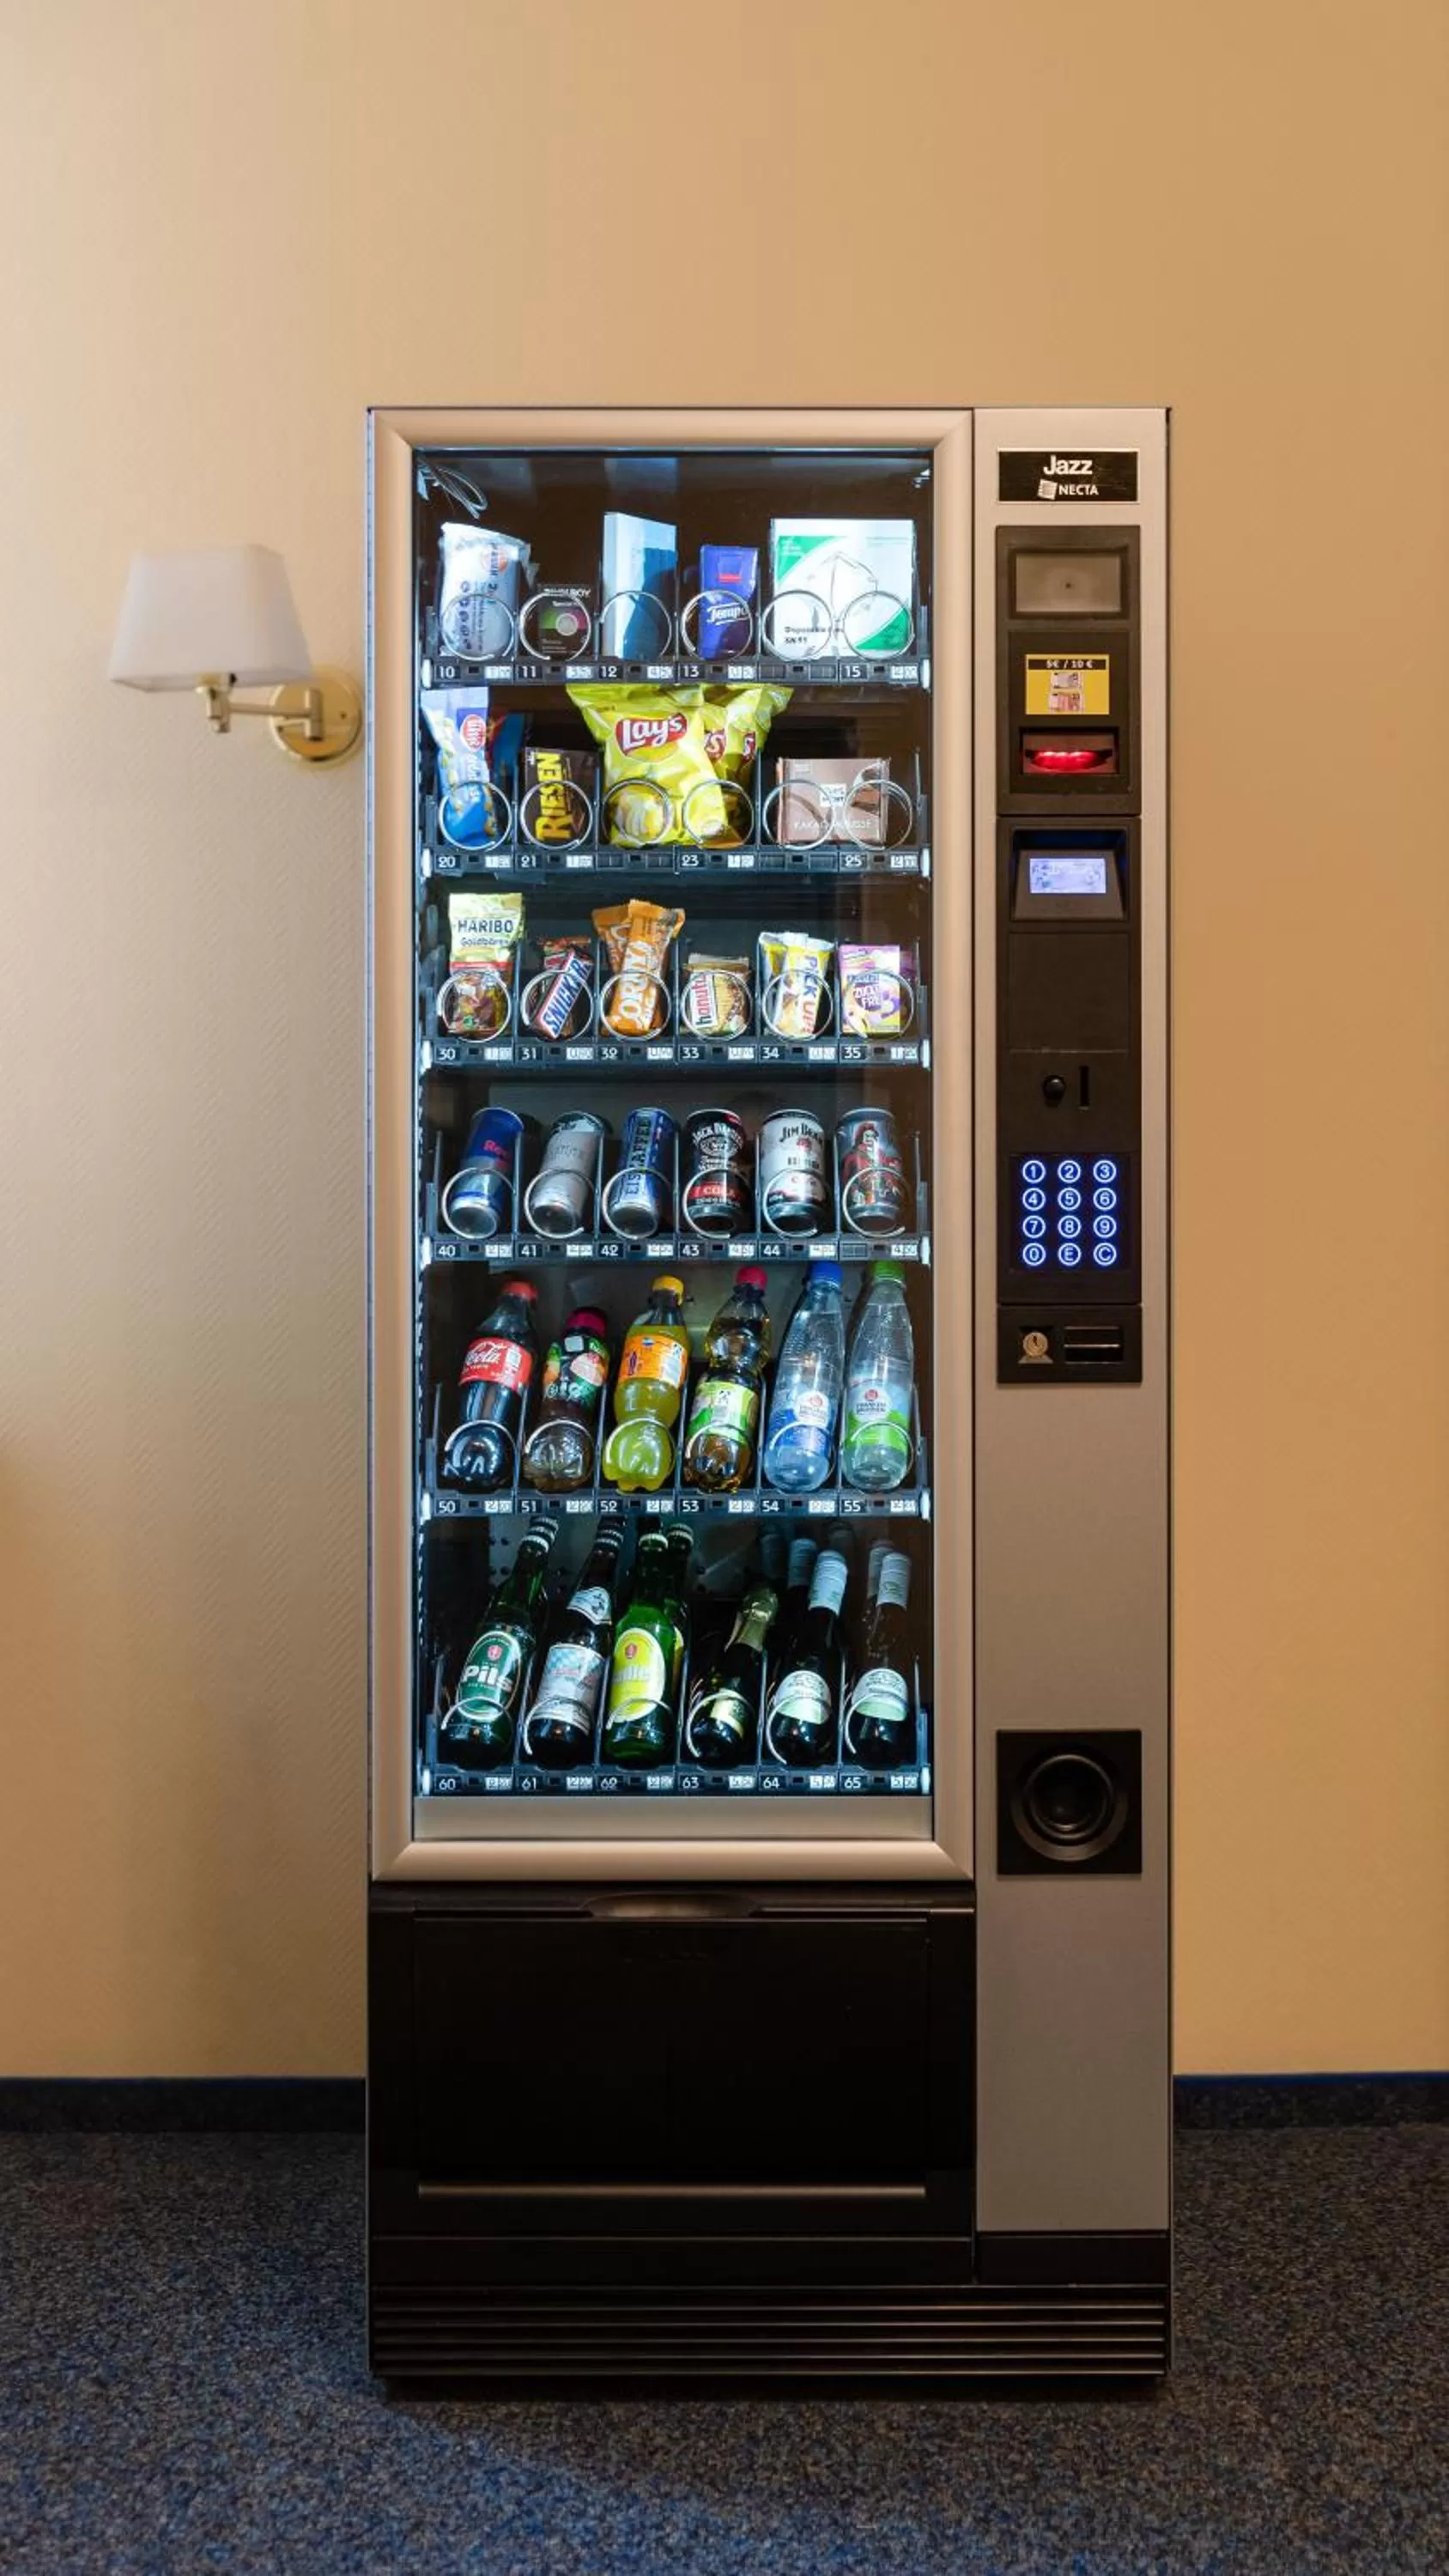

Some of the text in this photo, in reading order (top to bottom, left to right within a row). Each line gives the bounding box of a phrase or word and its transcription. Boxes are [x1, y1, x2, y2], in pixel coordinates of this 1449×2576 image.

[1043, 455, 1093, 476] Jazz
[1059, 483, 1099, 495] NECTA
[440, 665, 455, 678] 10
[522, 665, 537, 678] 11
[602, 665, 617, 677] 12
[682, 665, 700, 677] 13
[845, 665, 861, 677] 15
[535, 751, 573, 839] RIESEN
[438, 856, 456, 868] 20
[521, 854, 537, 868] 21
[682, 854, 699, 866] 23
[845, 854, 863, 867] 25
[458, 920, 514, 933] HARIBO
[543, 959, 593, 1032] SNICKR
[439, 1048, 456, 1060] 30
[522, 1047, 537, 1060] 31
[602, 1047, 618, 1060] 32
[682, 1047, 700, 1059] 33
[762, 1047, 779, 1060] 34
[844, 1045, 861, 1059] 35
[779, 1126, 799, 1143] JIM
[1030, 1166, 1037, 1178] 1
[1065, 1166, 1074, 1178] 2
[1100, 1166, 1109, 1178] 3
[1028, 1192, 1037, 1206] 4
[1064, 1192, 1073, 1206] 5
[1100, 1192, 1109, 1206] 6
[1030, 1220, 1039, 1233] 7
[1064, 1220, 1073, 1233] 8
[1100, 1219, 1109, 1233] 9
[438, 1244, 456, 1258] 40
[521, 1244, 537, 1256] 41
[601, 1244, 619, 1256] 42
[682, 1244, 700, 1256] 43
[763, 1244, 780, 1256] 44
[1030, 1249, 1039, 1261] 0
[1064, 1249, 1073, 1261] E
[1099, 1249, 1111, 1261] C
[439, 1500, 456, 1514] 50
[521, 1500, 537, 1513] 51
[600, 1500, 617, 1512] 52
[682, 1500, 700, 1512] 53
[762, 1500, 779, 1512] 54
[844, 1499, 861, 1513] 55
[460, 1664, 513, 1692] Pils
[439, 1778, 456, 1790] 60
[521, 1777, 537, 1790] 61
[600, 1777, 618, 1789] 62
[682, 1777, 699, 1789] 63
[763, 1777, 779, 1789] 64
[844, 1777, 861, 1789] 65
